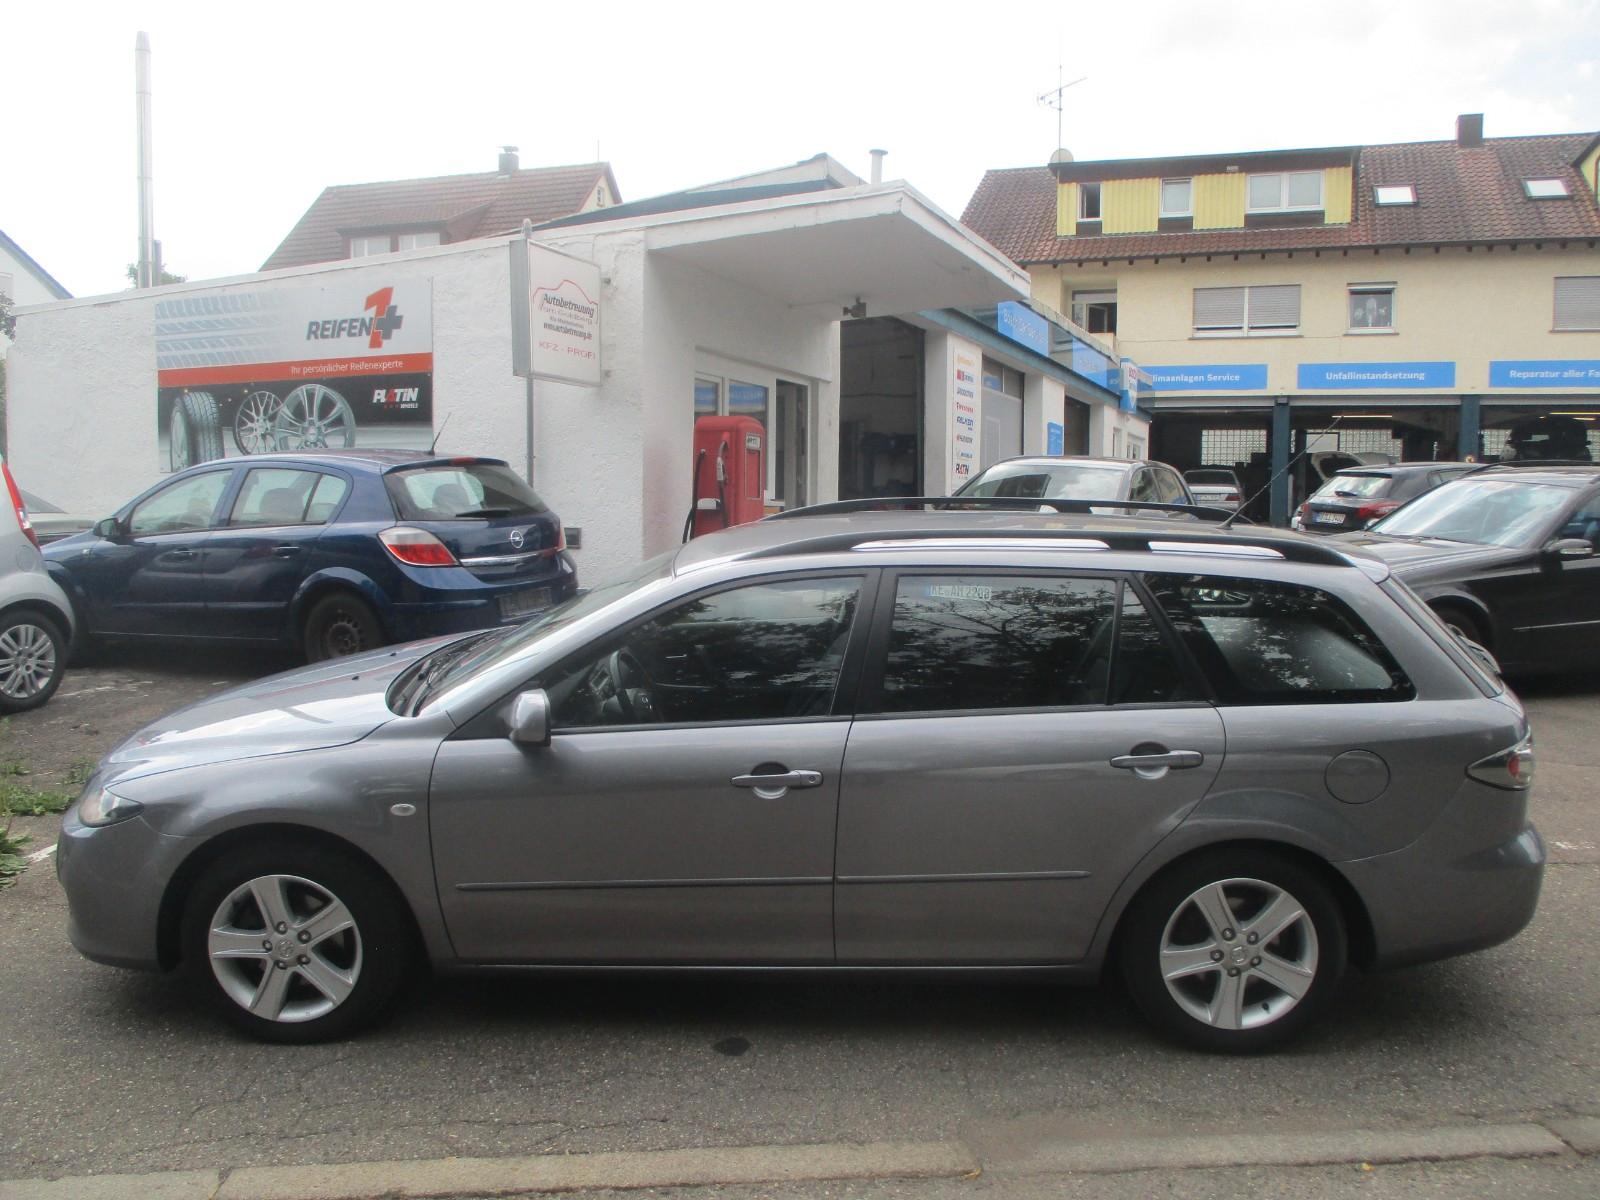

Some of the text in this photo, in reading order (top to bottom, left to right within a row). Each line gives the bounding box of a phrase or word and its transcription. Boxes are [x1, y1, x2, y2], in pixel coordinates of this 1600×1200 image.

[306, 317, 373, 340] REIFEN
[538, 340, 559, 352] KFZ
[350, 360, 404, 371] Reifenexperte
[1152, 373, 1240, 384] limaanlagen Service
[1326, 371, 1425, 381] Unfallinstandsetzung
[1509, 369, 1559, 380] Reparatur
